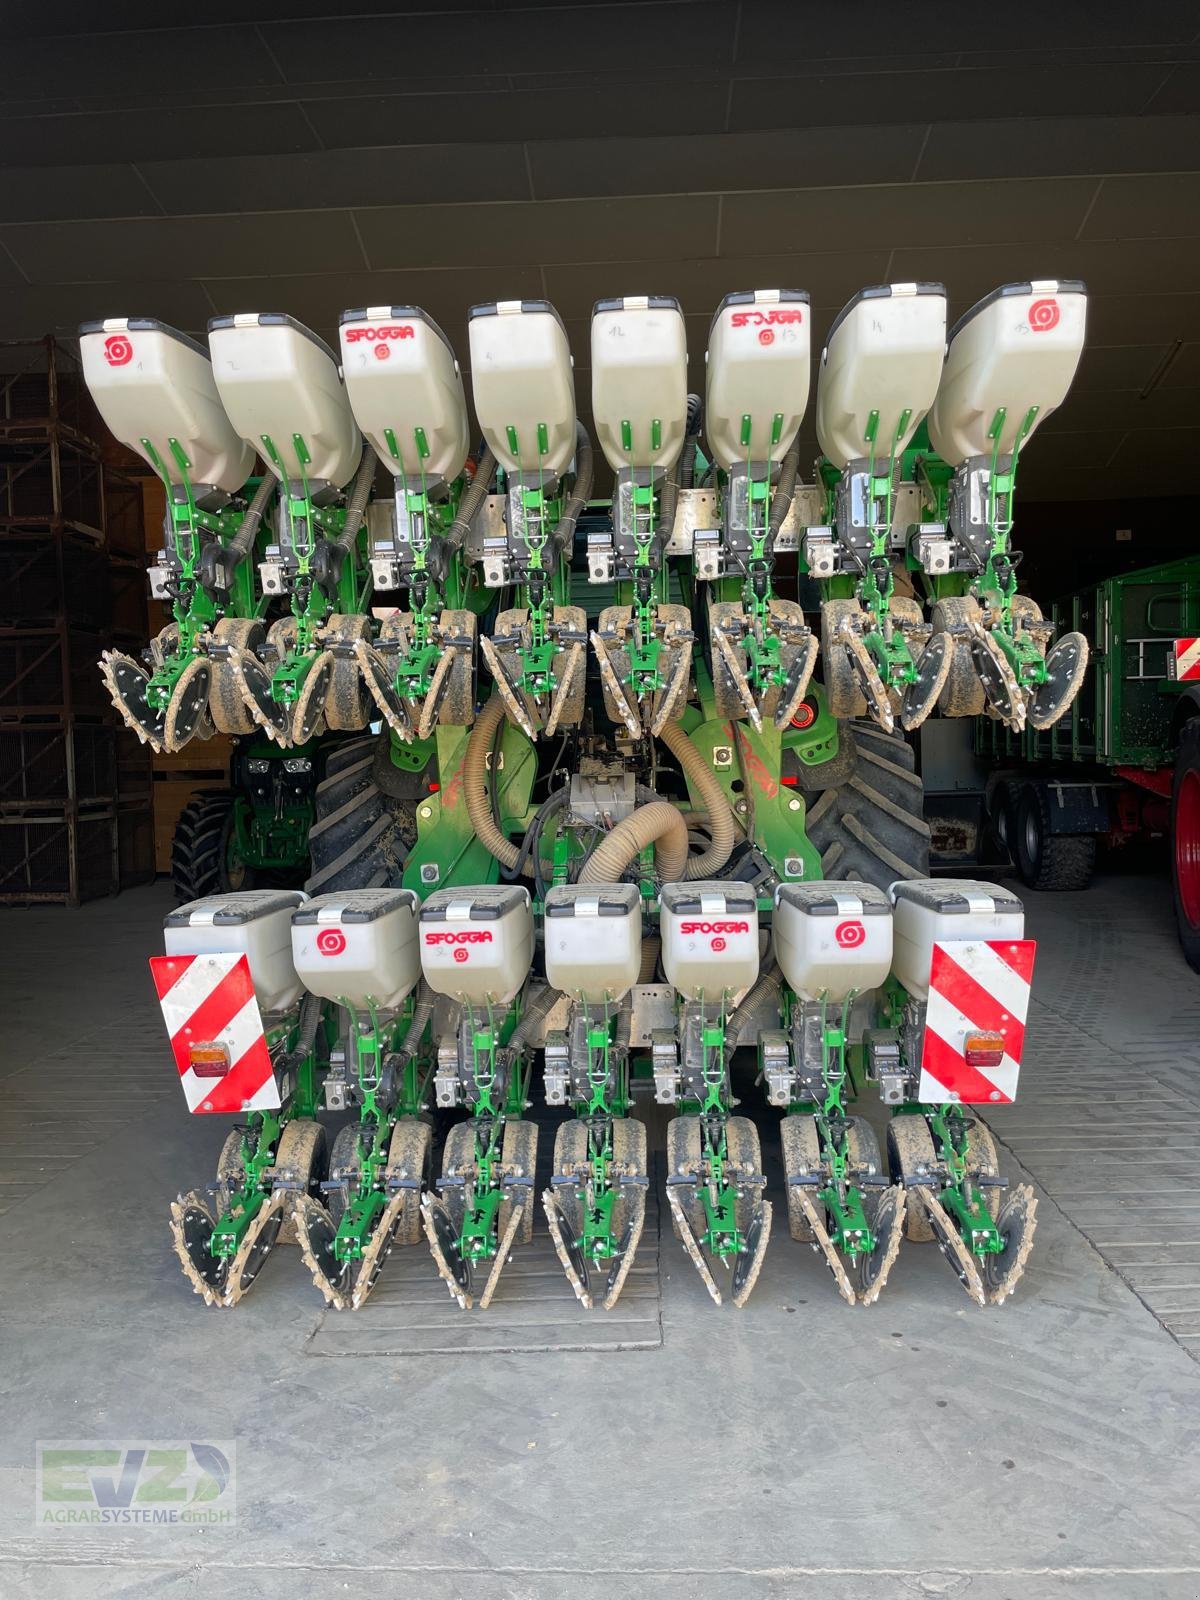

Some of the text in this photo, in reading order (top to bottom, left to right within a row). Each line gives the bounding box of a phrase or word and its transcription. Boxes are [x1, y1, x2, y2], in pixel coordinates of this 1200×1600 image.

[345, 325, 415, 344] SFOGGIA
[680, 921, 749, 935] SFOGGIA
[425, 930, 493, 945] SFOGGIA
